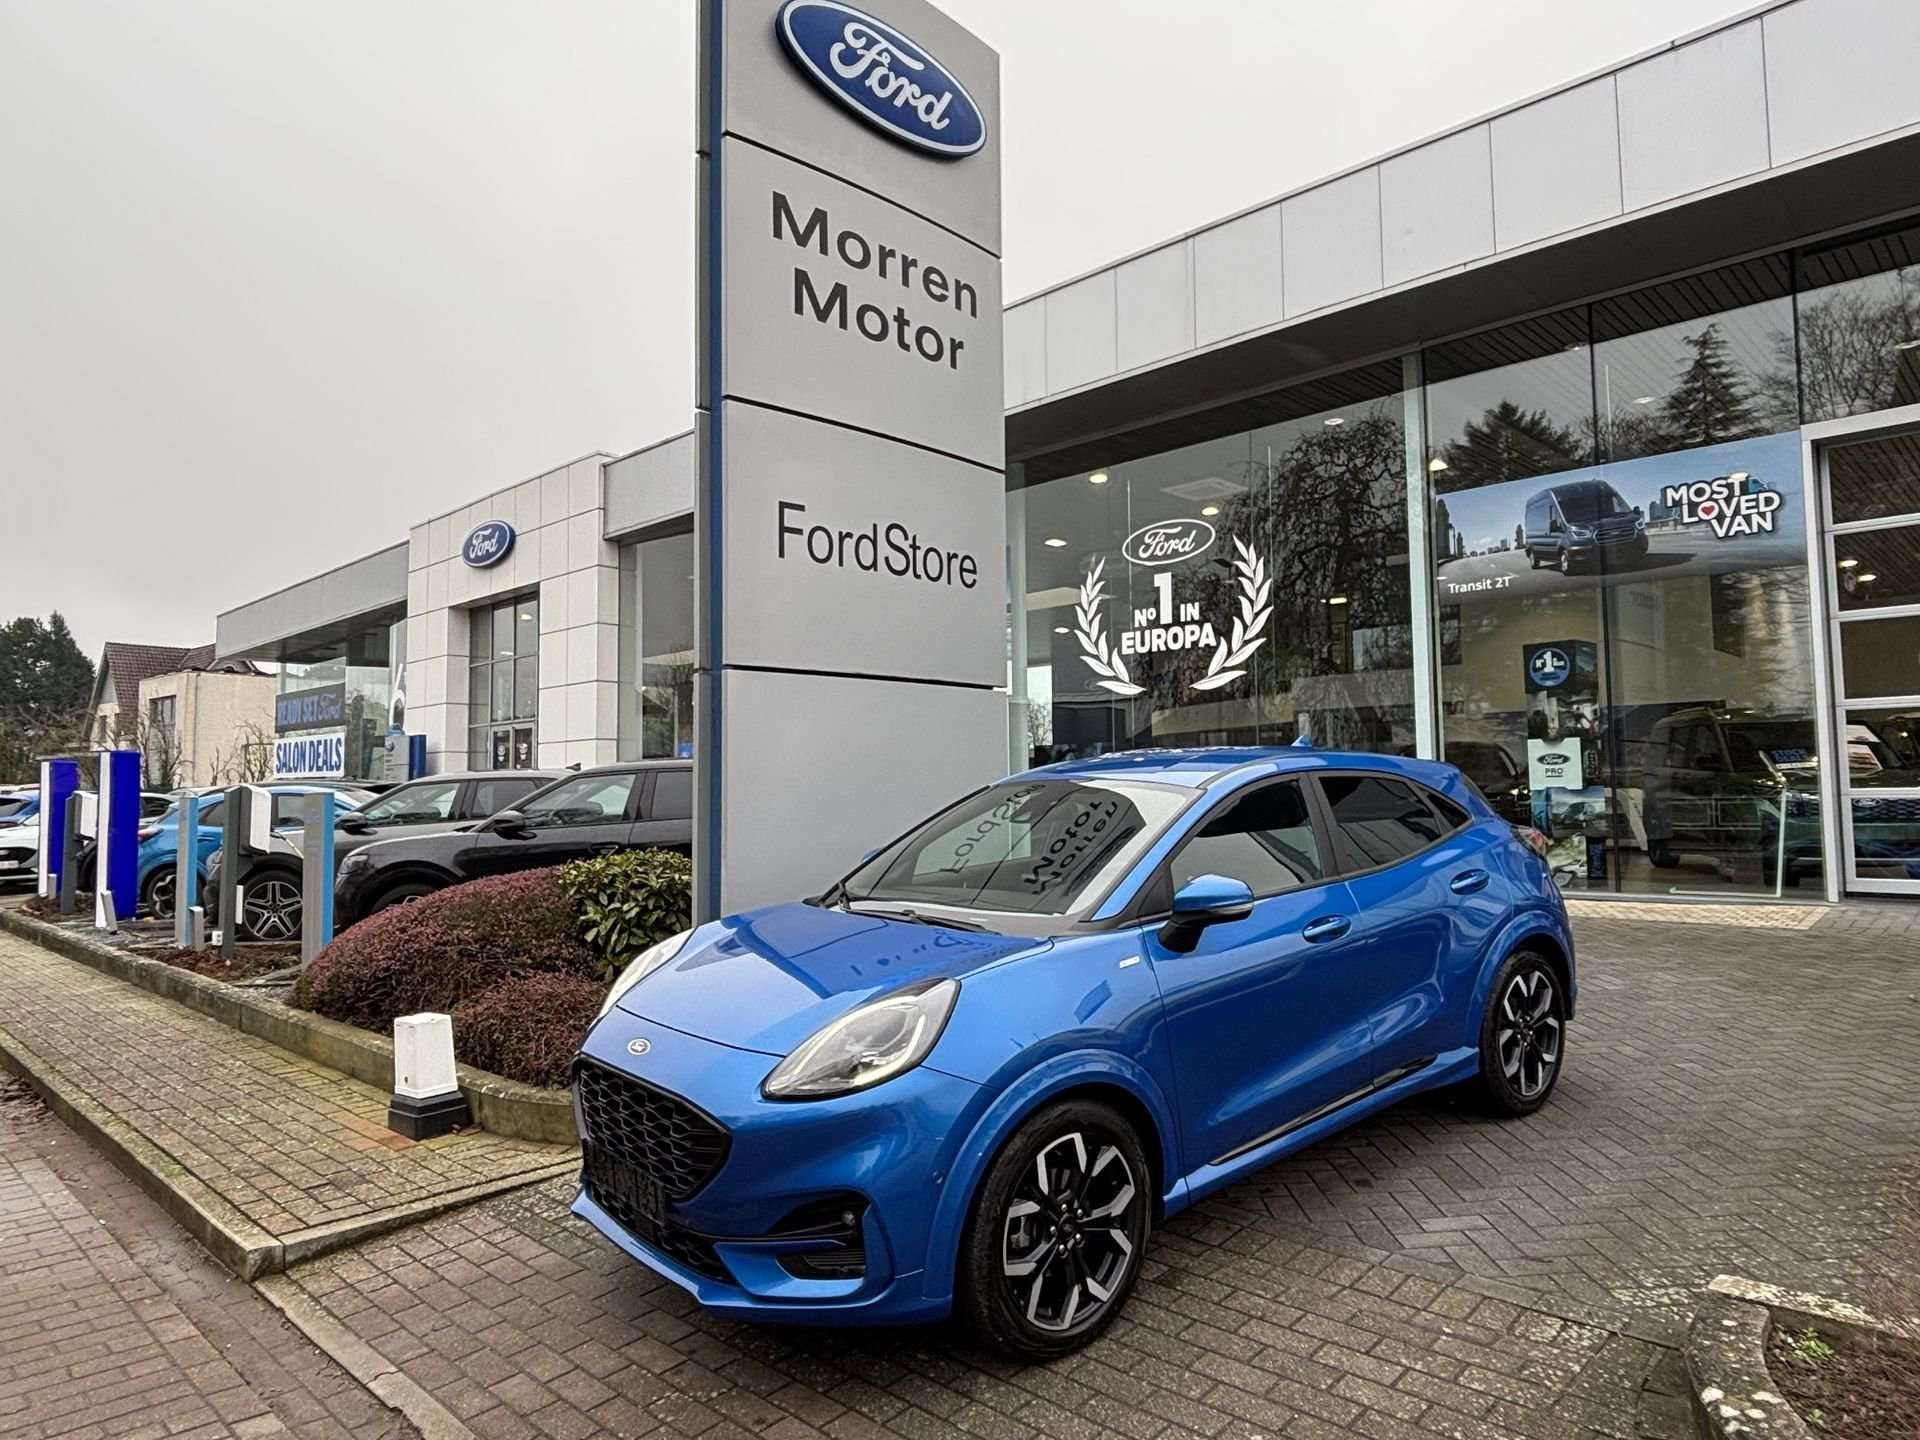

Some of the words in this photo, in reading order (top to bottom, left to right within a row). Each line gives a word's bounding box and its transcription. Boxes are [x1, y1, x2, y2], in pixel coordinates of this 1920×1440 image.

[830, 21, 952, 131] Ford
[771, 190, 978, 319] Morren
[793, 266, 965, 371] Motor
[1665, 478, 1745, 507] MOST
[1682, 491, 1780, 524] LOVED
[1713, 511, 1774, 538] VAN
[469, 528, 499, 560] Ford
[777, 500, 978, 589] FordStore
[1138, 526, 1196, 560] Ford
[1153, 572, 1173, 625] 1
[1180, 602, 1200, 622] IN
[1448, 579, 1493, 594] Transit
[1496, 577, 1510, 589] 2T
[1121, 623, 1217, 655] EUROPA
[302, 696, 318, 723] SET
[318, 692, 343, 720] Ford
[276, 740, 307, 774] SALON
[308, 737, 343, 772] DEALS
[1545, 768, 1563, 776] PRO
